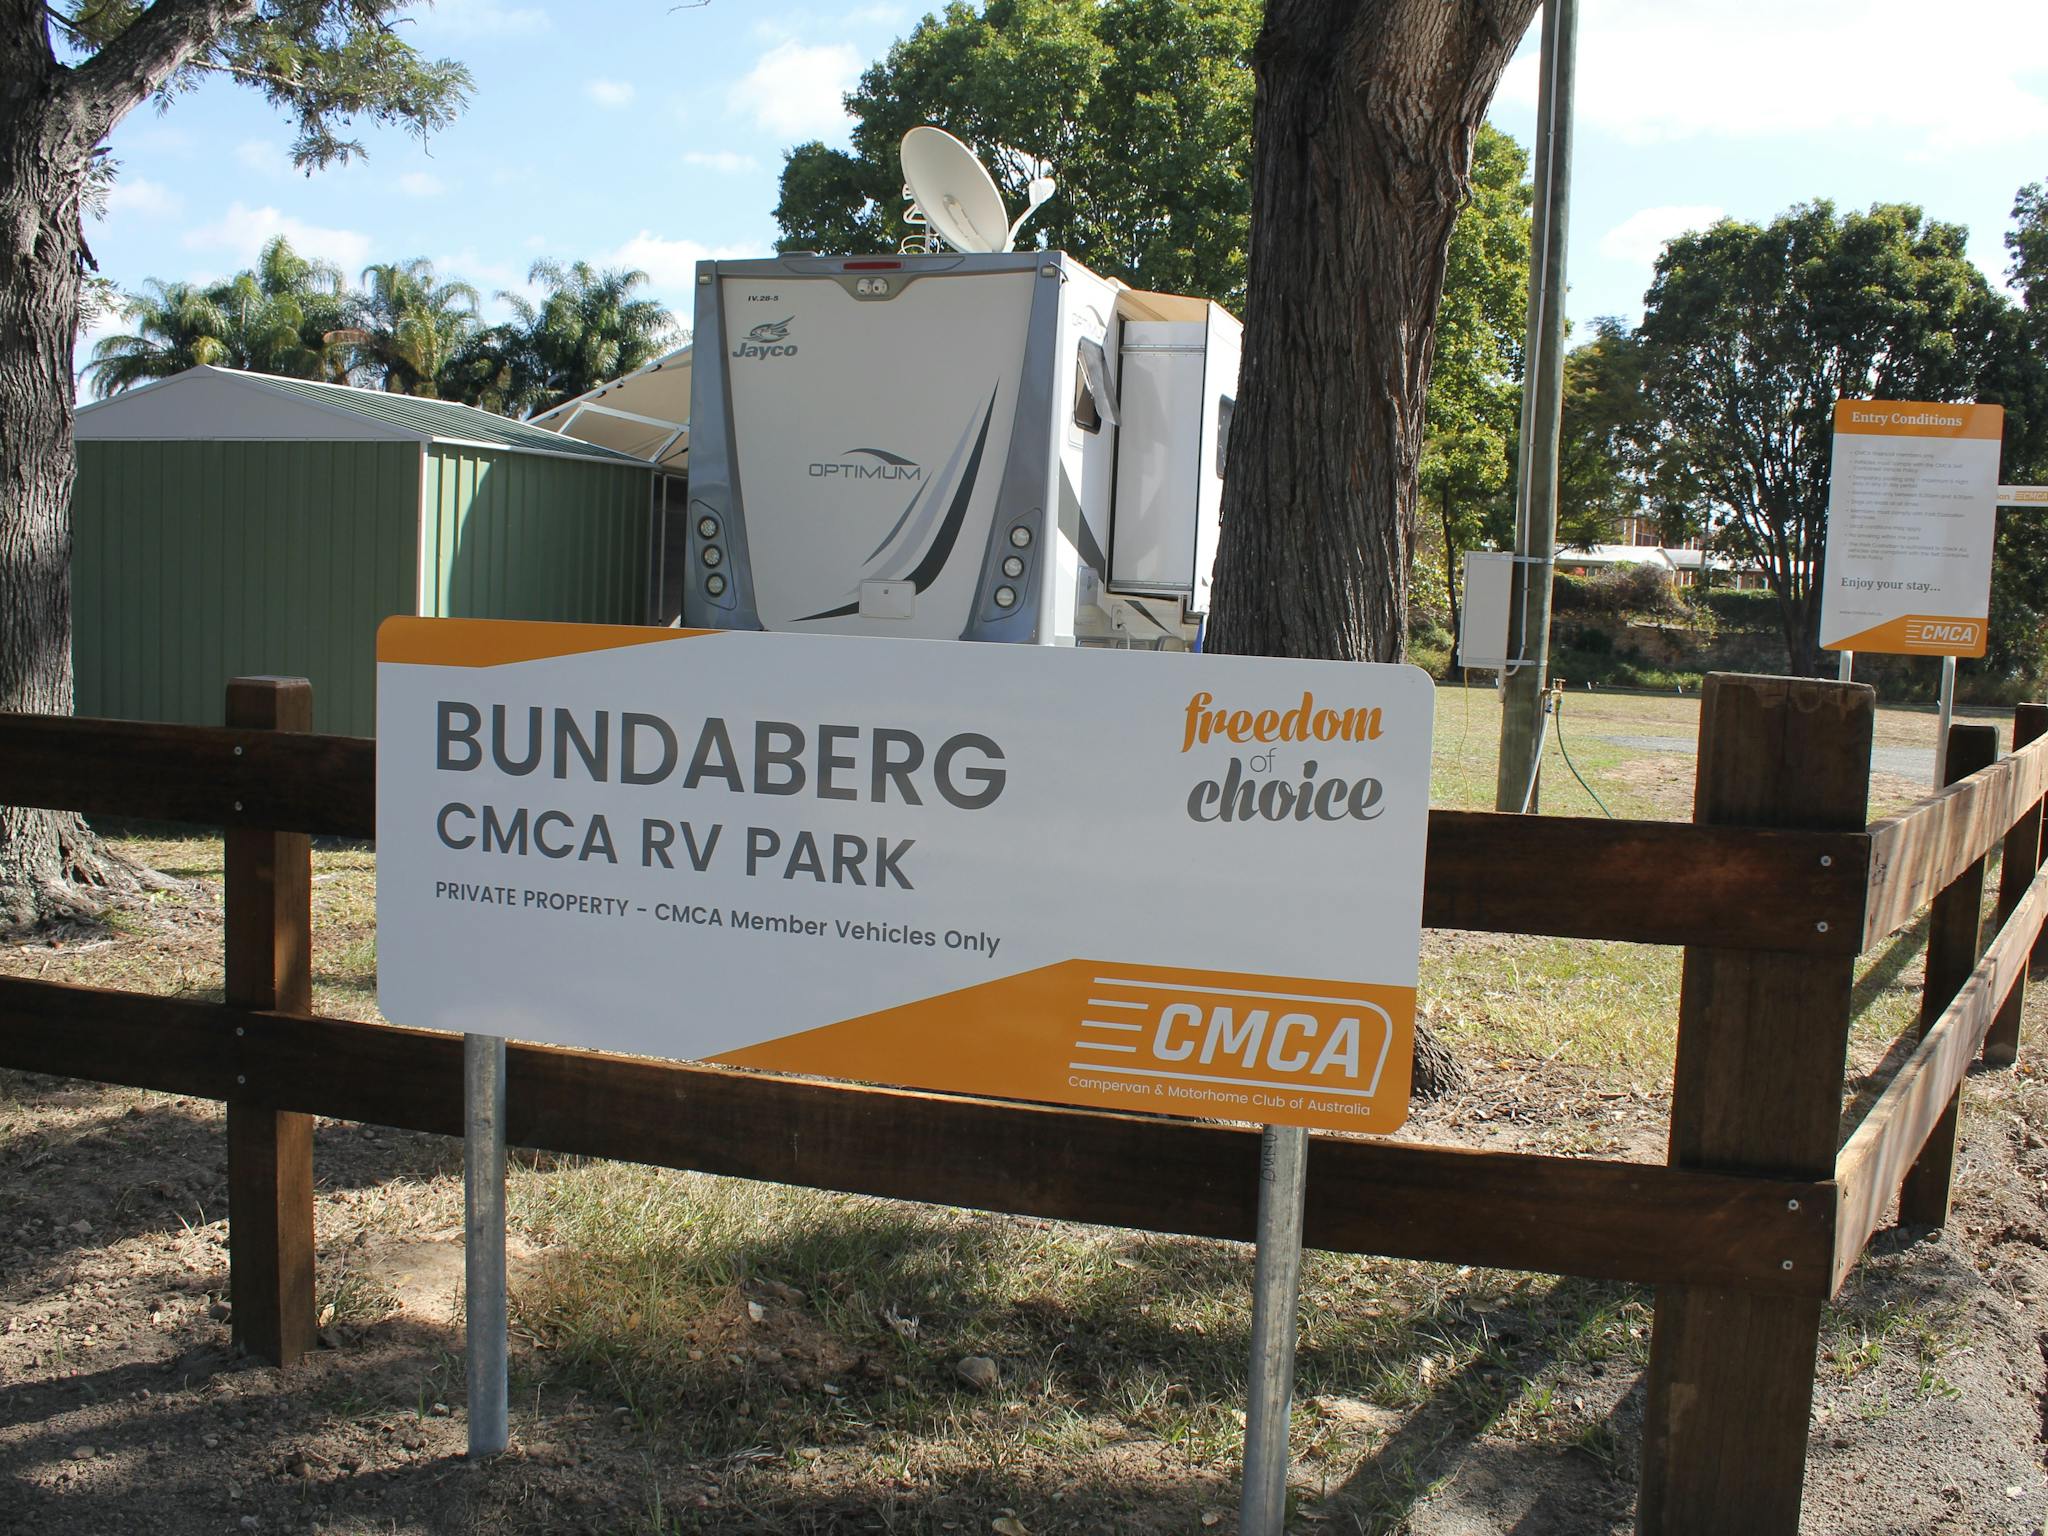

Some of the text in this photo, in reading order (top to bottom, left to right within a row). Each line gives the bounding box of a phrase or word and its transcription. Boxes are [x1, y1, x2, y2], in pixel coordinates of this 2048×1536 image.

[732, 342, 798, 360] Jayco
[1852, 411, 1963, 427] Entry Conditions
[808, 463, 920, 480] OPTIMUM
[1841, 577, 1941, 593] Enjoy your stay...
[1921, 624, 1973, 642] CMCA
[1181, 691, 1384, 753] freedom
[436, 700, 1007, 810] BUNDABERG
[1250, 747, 1277, 773] of
[1187, 757, 1385, 823] choice
[436, 801, 916, 890] CMCA RV PARK
[435, 880, 517, 906] PRIVATE
[523, 889, 629, 917] PROPERTY
[654, 903, 723, 927] CMCA
[730, 909, 828, 937] Member
[834, 919, 936, 947] Vehicles
[944, 929, 1001, 959] Only
[1152, 1003, 1360, 1079] CMCA
[1068, 1075, 1371, 1116] Campervan & Motorhome Club of Australia
